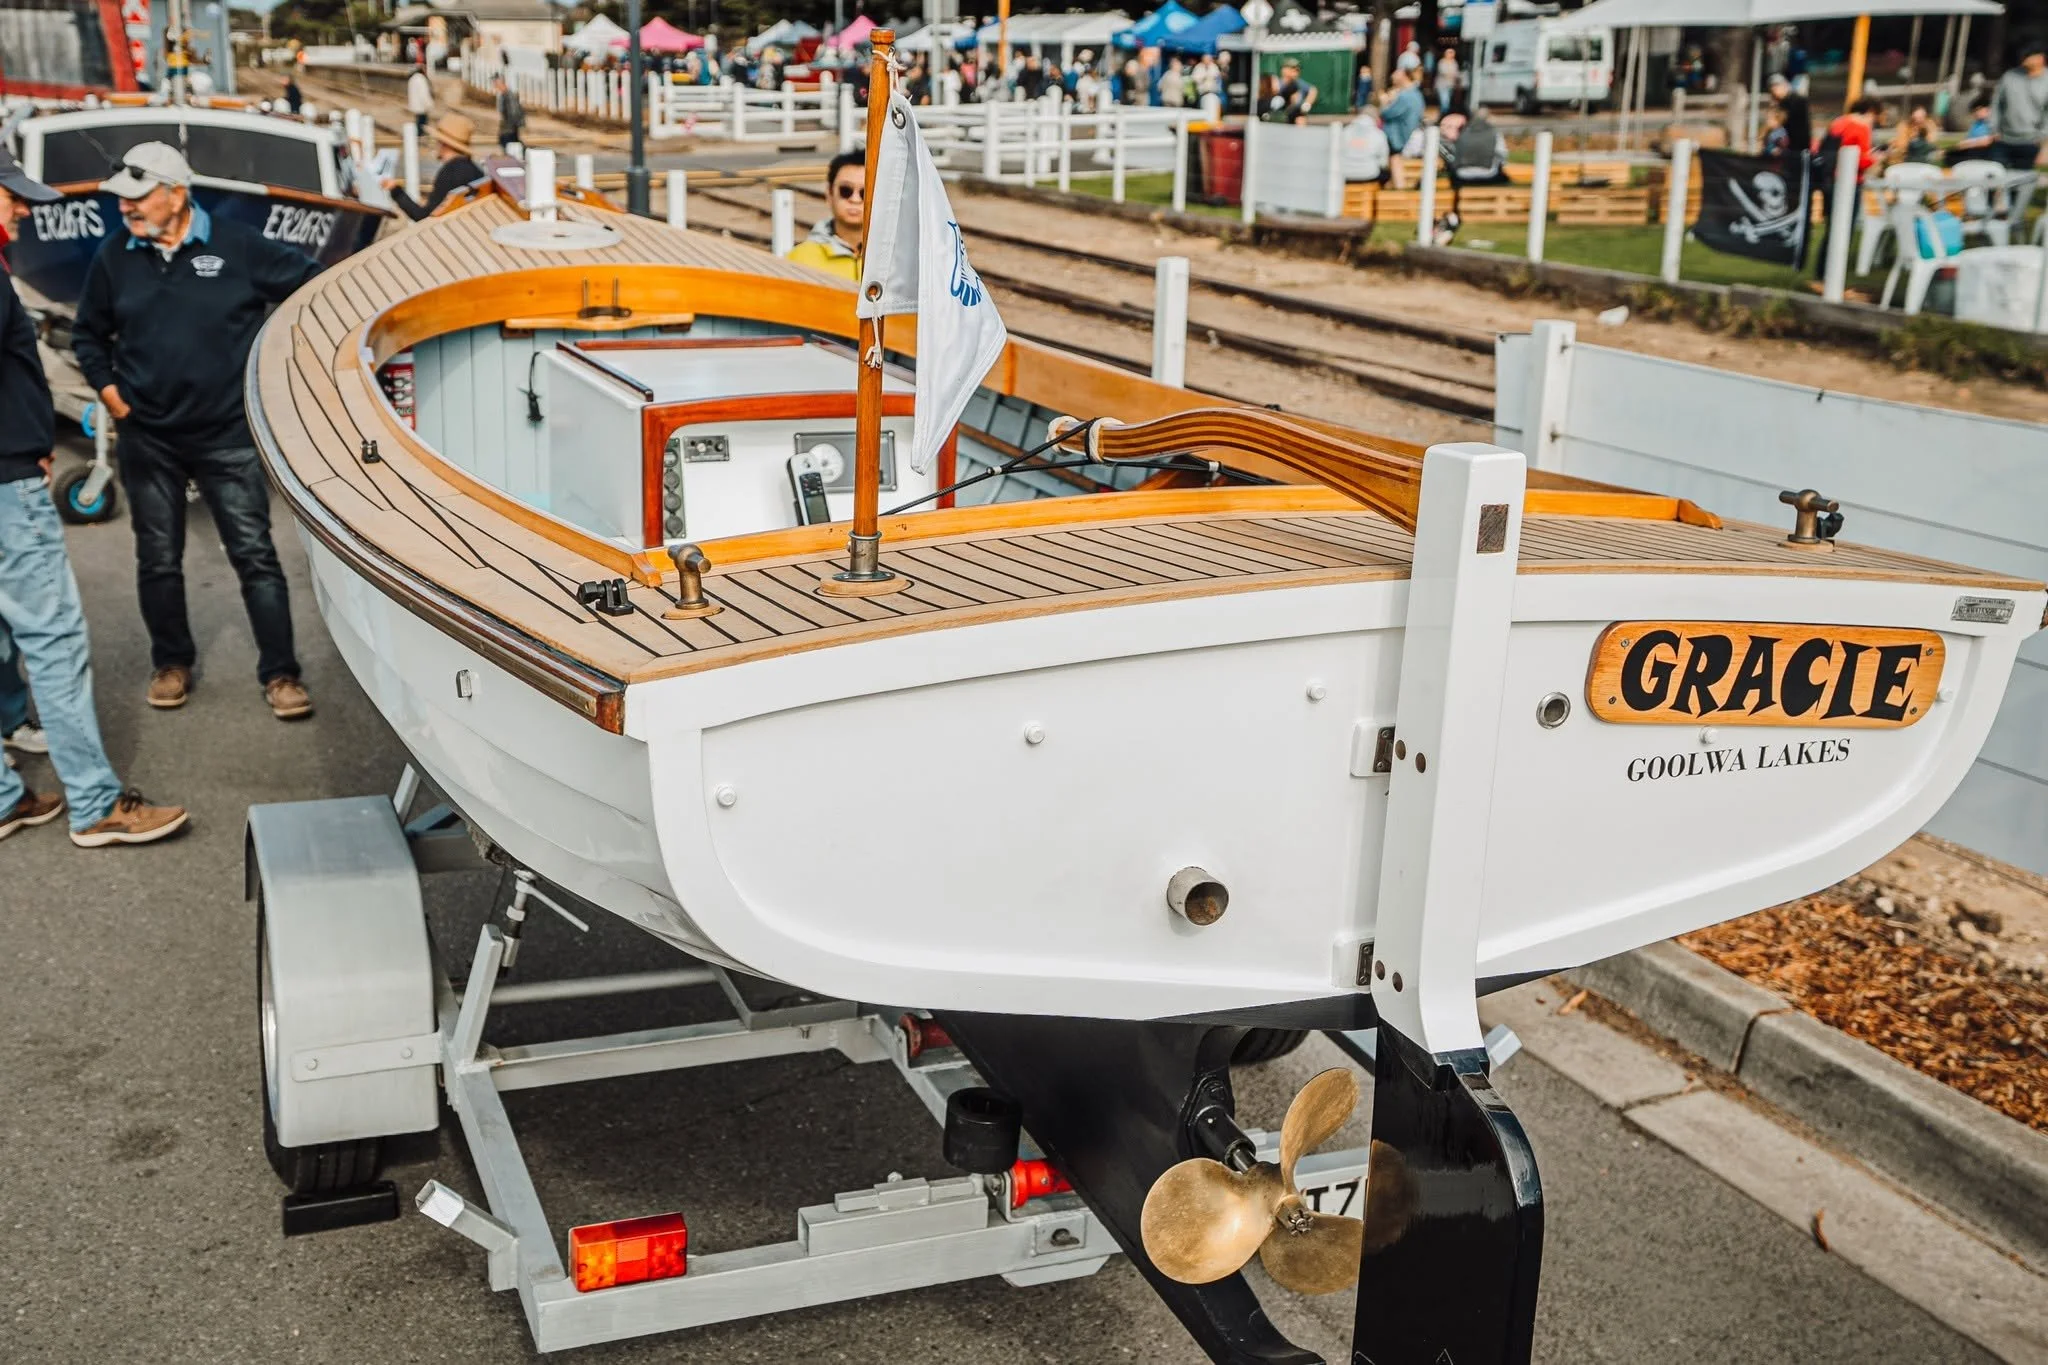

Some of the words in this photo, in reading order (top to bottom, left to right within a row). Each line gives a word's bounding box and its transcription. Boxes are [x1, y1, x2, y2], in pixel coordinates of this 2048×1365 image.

[1621, 629, 1922, 721] GRACIE
[1627, 747, 1747, 782] GOOLWA
[1756, 738, 1851, 770] LAKES
[1306, 1179, 1368, 1216] T7
